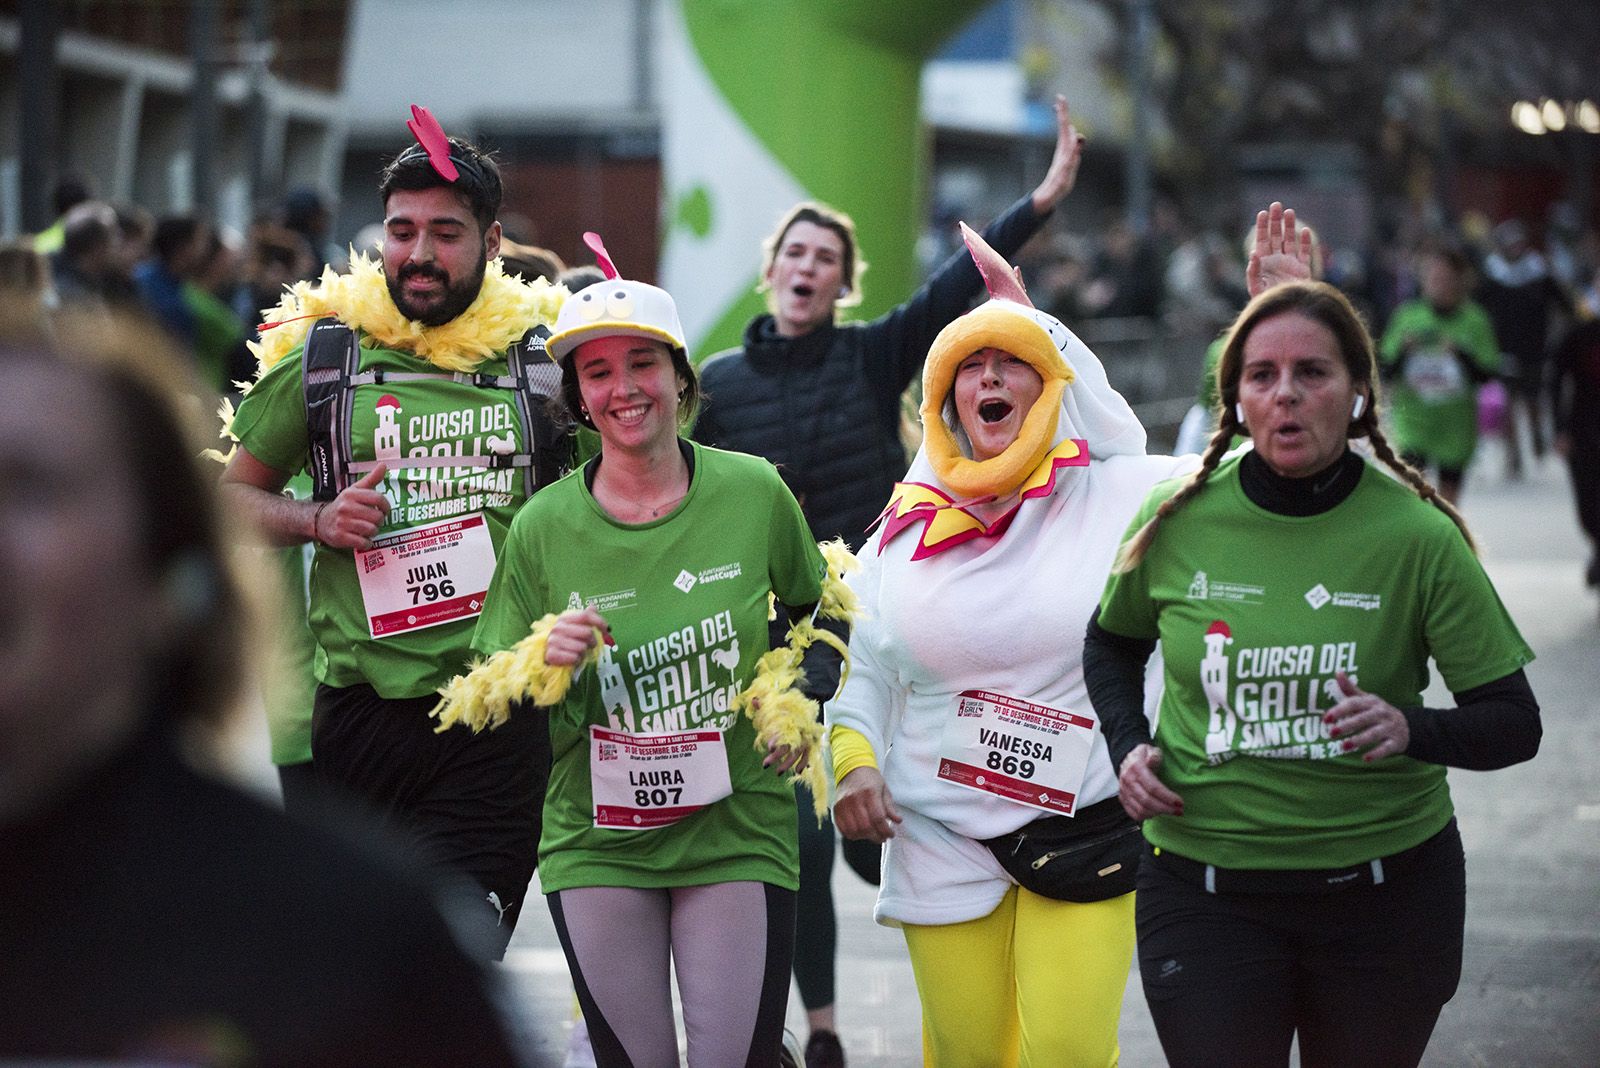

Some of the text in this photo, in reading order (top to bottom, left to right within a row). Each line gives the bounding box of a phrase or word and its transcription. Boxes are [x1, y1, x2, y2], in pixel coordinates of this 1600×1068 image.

[409, 403, 513, 443] CURSA DEL
[407, 468, 515, 505] SANT CUGAT
[391, 509, 404, 525] DE
[408, 499, 467, 522] DESEMBRE
[470, 495, 483, 512] DE
[485, 493, 513, 507] 2023
[391, 532, 463, 555] 31 DE DESEMBRE DE 2023
[406, 561, 448, 585] JUAN
[699, 568, 742, 584] SantCugat
[407, 579, 455, 605] 796
[1332, 597, 1380, 610] SantCugat
[627, 609, 737, 676] CURSA DEL
[1236, 642, 1358, 679] CURSA DEL
[635, 652, 716, 714] GALL
[1235, 678, 1324, 722] GALL
[641, 704, 687, 732] SANT
[703, 717, 717, 729] DE
[994, 705, 1068, 731] 31 DE DESEMBRE DE 2023
[979, 728, 1052, 762] VANESSA
[1239, 720, 1290, 750] SANT
[632, 747, 638, 755] DE
[639, 746, 670, 755] DESEMBRE
[681, 744, 697, 752] 2023
[1311, 744, 1326, 760] DE
[629, 769, 685, 786] LAURA
[986, 751, 1035, 779] 869
[635, 788, 683, 807] 807
